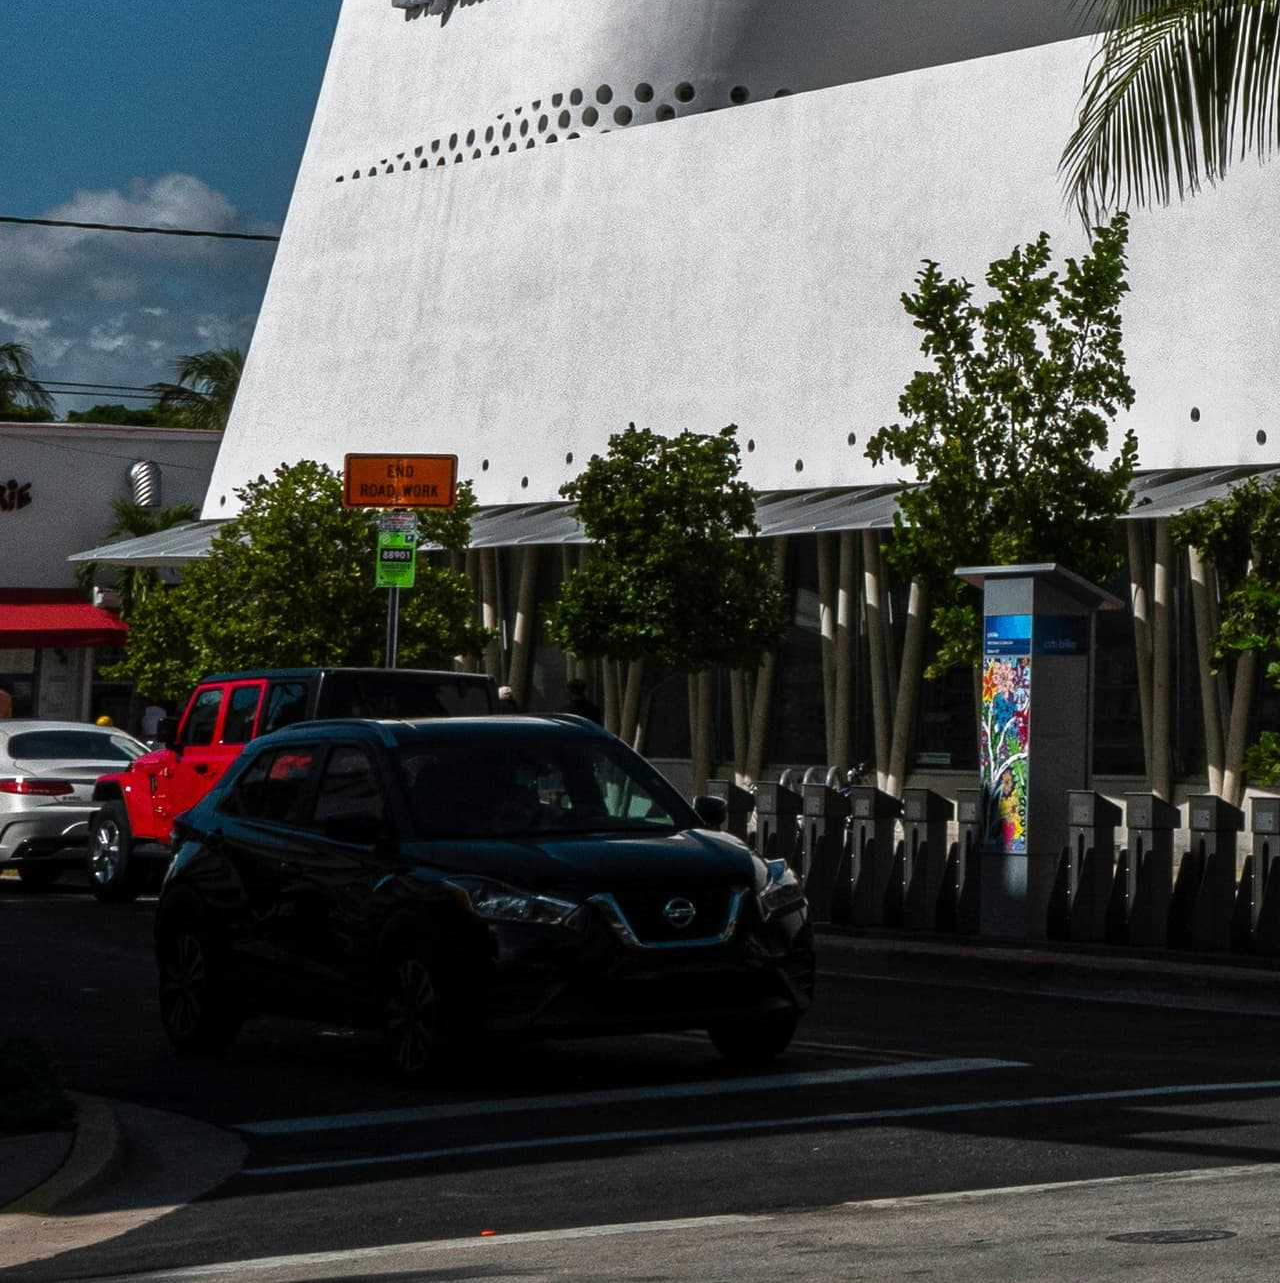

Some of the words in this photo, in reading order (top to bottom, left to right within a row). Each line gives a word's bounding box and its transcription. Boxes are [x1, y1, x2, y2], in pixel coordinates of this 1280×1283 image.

[387, 464, 414, 478] END
[360, 484, 396, 498] ROAD
[403, 484, 439, 498] WORK
